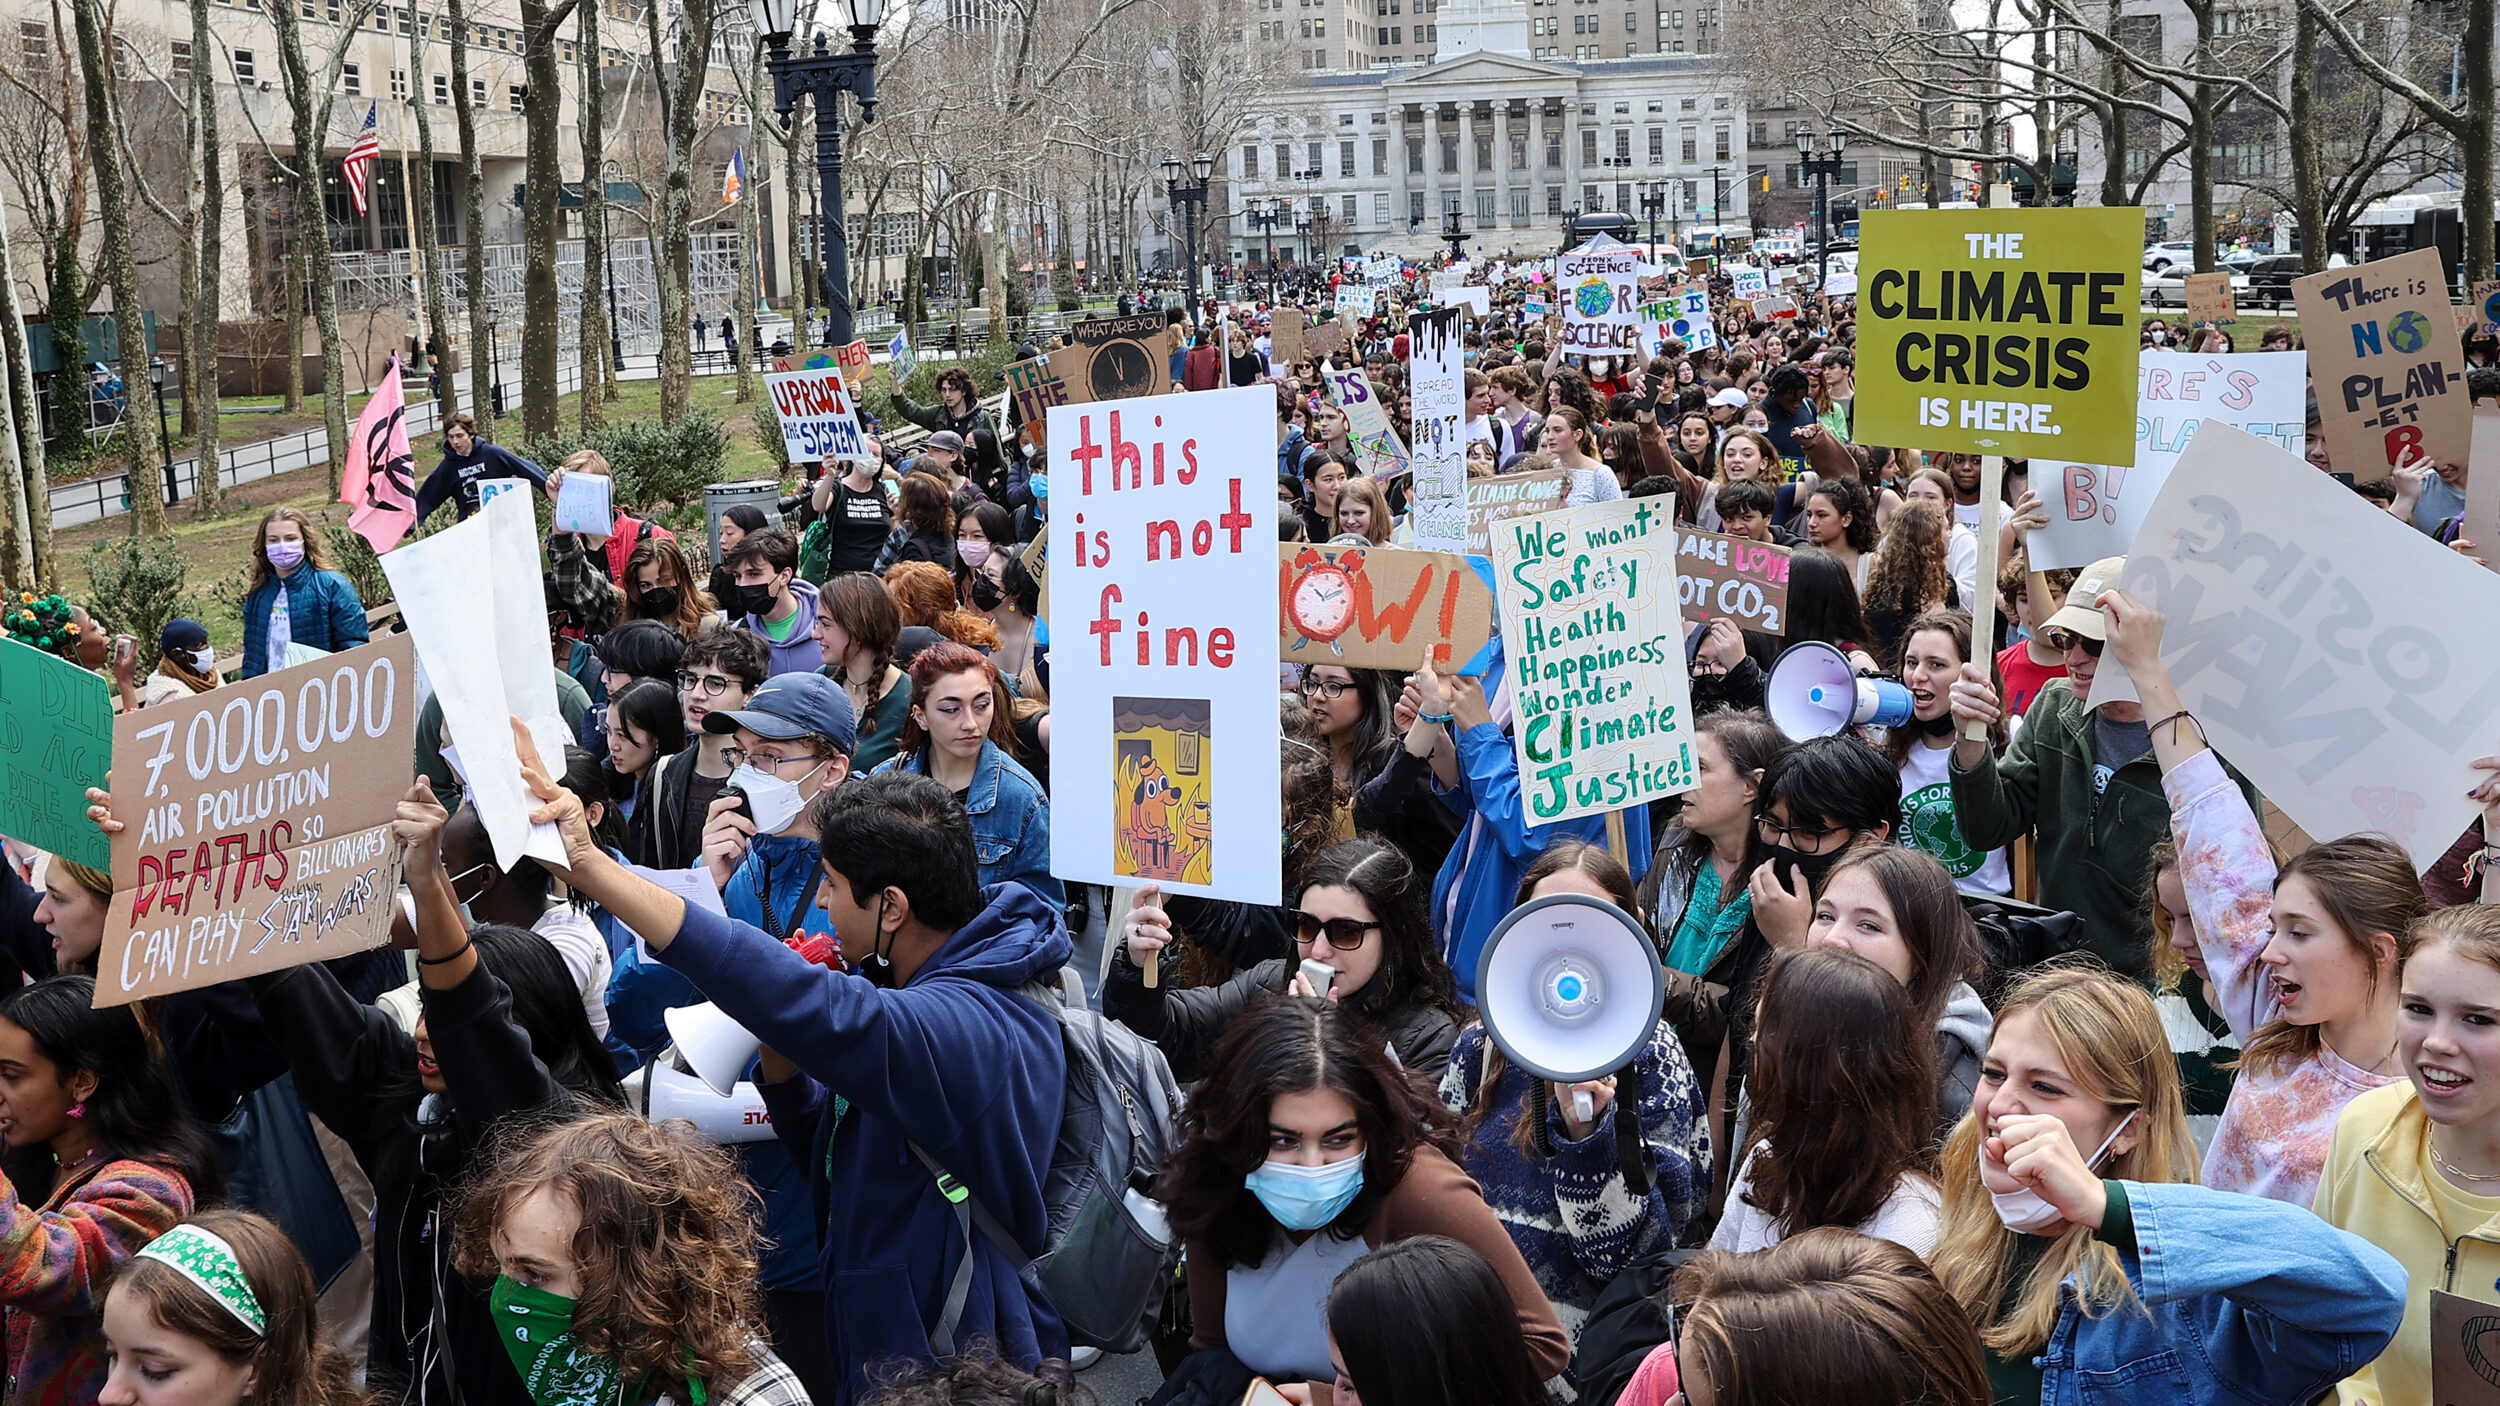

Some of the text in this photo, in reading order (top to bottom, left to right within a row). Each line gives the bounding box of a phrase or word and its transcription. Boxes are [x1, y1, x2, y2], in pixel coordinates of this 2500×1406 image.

[1964, 233, 2024, 259] THE
[1564, 262, 1631, 277] SCIENCE
[1338, 286, 1374, 297] BELIEVE
[1637, 294, 1704, 324] THERE IS
[1870, 269, 2125, 326] CLIMATE
[2321, 277, 2426, 312] There is
[1076, 317, 1163, 338] WHAT ARE YOU
[1563, 322, 1635, 349] SCIENCE
[837, 341, 871, 368] HER
[1895, 332, 2090, 391] CRISIS
[1008, 358, 1060, 391] TELL
[1334, 372, 1368, 405] IS
[1416, 379, 1454, 394] SPREAD
[772, 377, 846, 417] UPROOT
[1018, 382, 1069, 421] THE
[1412, 394, 1457, 409] THE WORD
[1919, 396, 2062, 435] IS HERE.
[784, 420, 862, 455] THE SYSTEM
[1415, 415, 1458, 445] NOT
[2384, 424, 2425, 467] B
[457, 462, 486, 478] HOCKEY
[1071, 409, 1198, 496] this
[1467, 479, 1563, 506] CLIMATE CHANGE
[1076, 478, 1253, 568] is not
[1418, 519, 1466, 540] CHANGE
[1515, 521, 1566, 560] We
[1513, 554, 1637, 609] Safety
[1677, 574, 1713, 606] OT
[1090, 583, 1235, 669] fine
[1524, 601, 1626, 654] Health
[1518, 635, 1667, 690] Happiness
[1520, 676, 1632, 719] Wonder
[136, 657, 396, 798] 7,000,000
[1525, 696, 1676, 764] Climate
[1533, 742, 1692, 818] Justice!
[137, 803, 186, 850] AIR
[196, 761, 330, 834] POLLUTION
[1898, 786, 1951, 849] RIDAYS FOR
[130, 820, 292, 929] DEATHS
[302, 815, 325, 843] SO
[120, 928, 181, 992] CAN
[182, 907, 246, 980] PLAY
[743, 1112, 772, 1125] YLE
